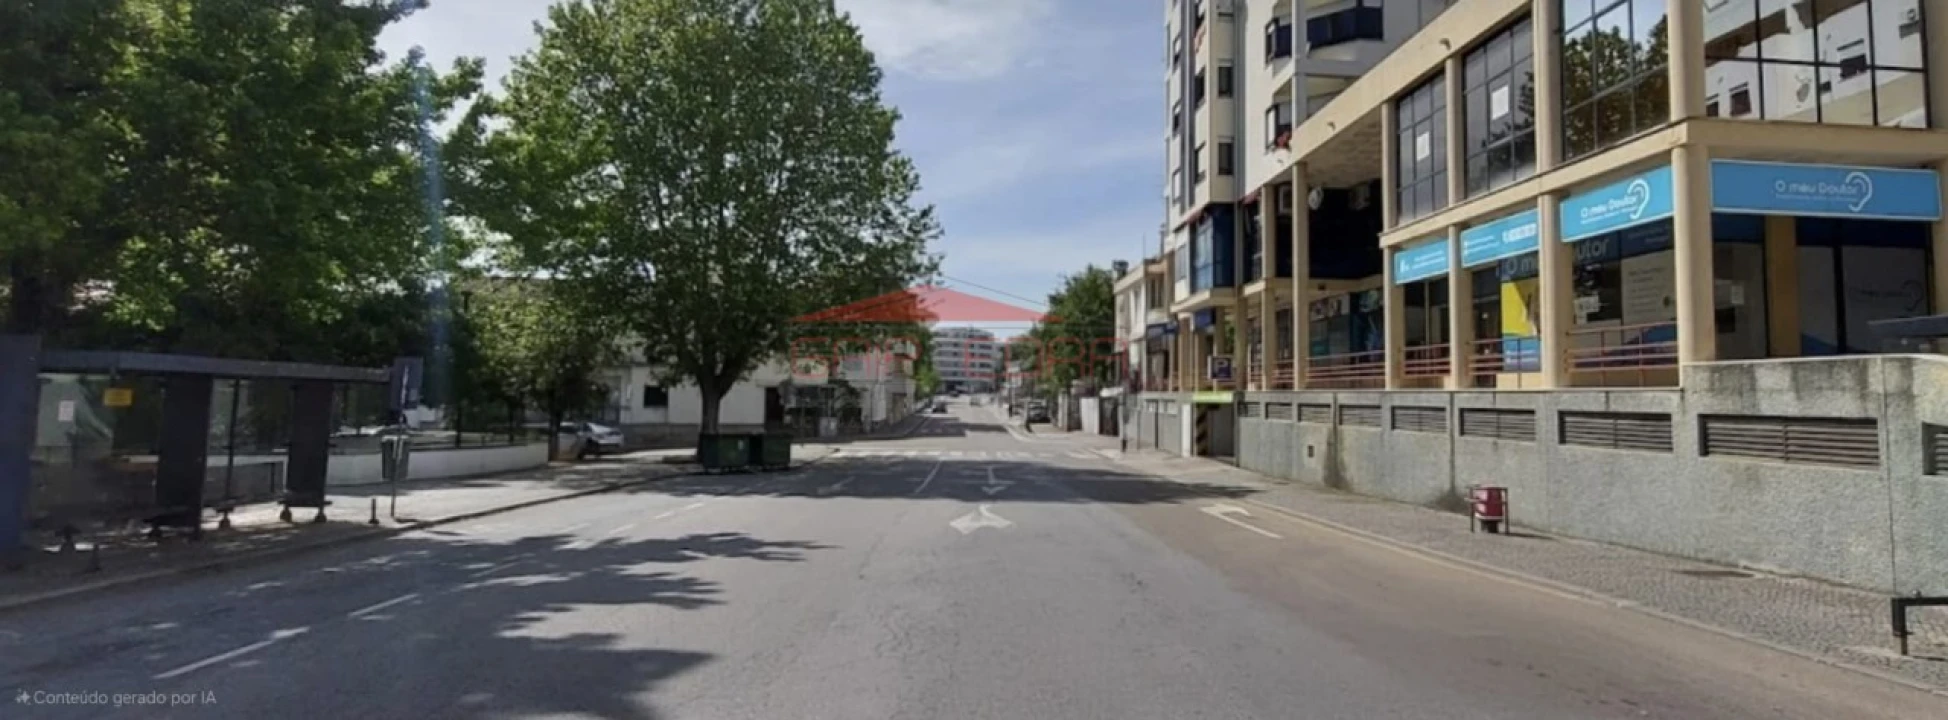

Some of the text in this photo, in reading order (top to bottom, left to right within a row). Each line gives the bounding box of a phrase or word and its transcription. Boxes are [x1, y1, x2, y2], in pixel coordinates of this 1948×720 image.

[1775, 179, 1858, 196] O meu Doutor
[1580, 207, 1588, 218] O
[1214, 358, 1229, 375] P
